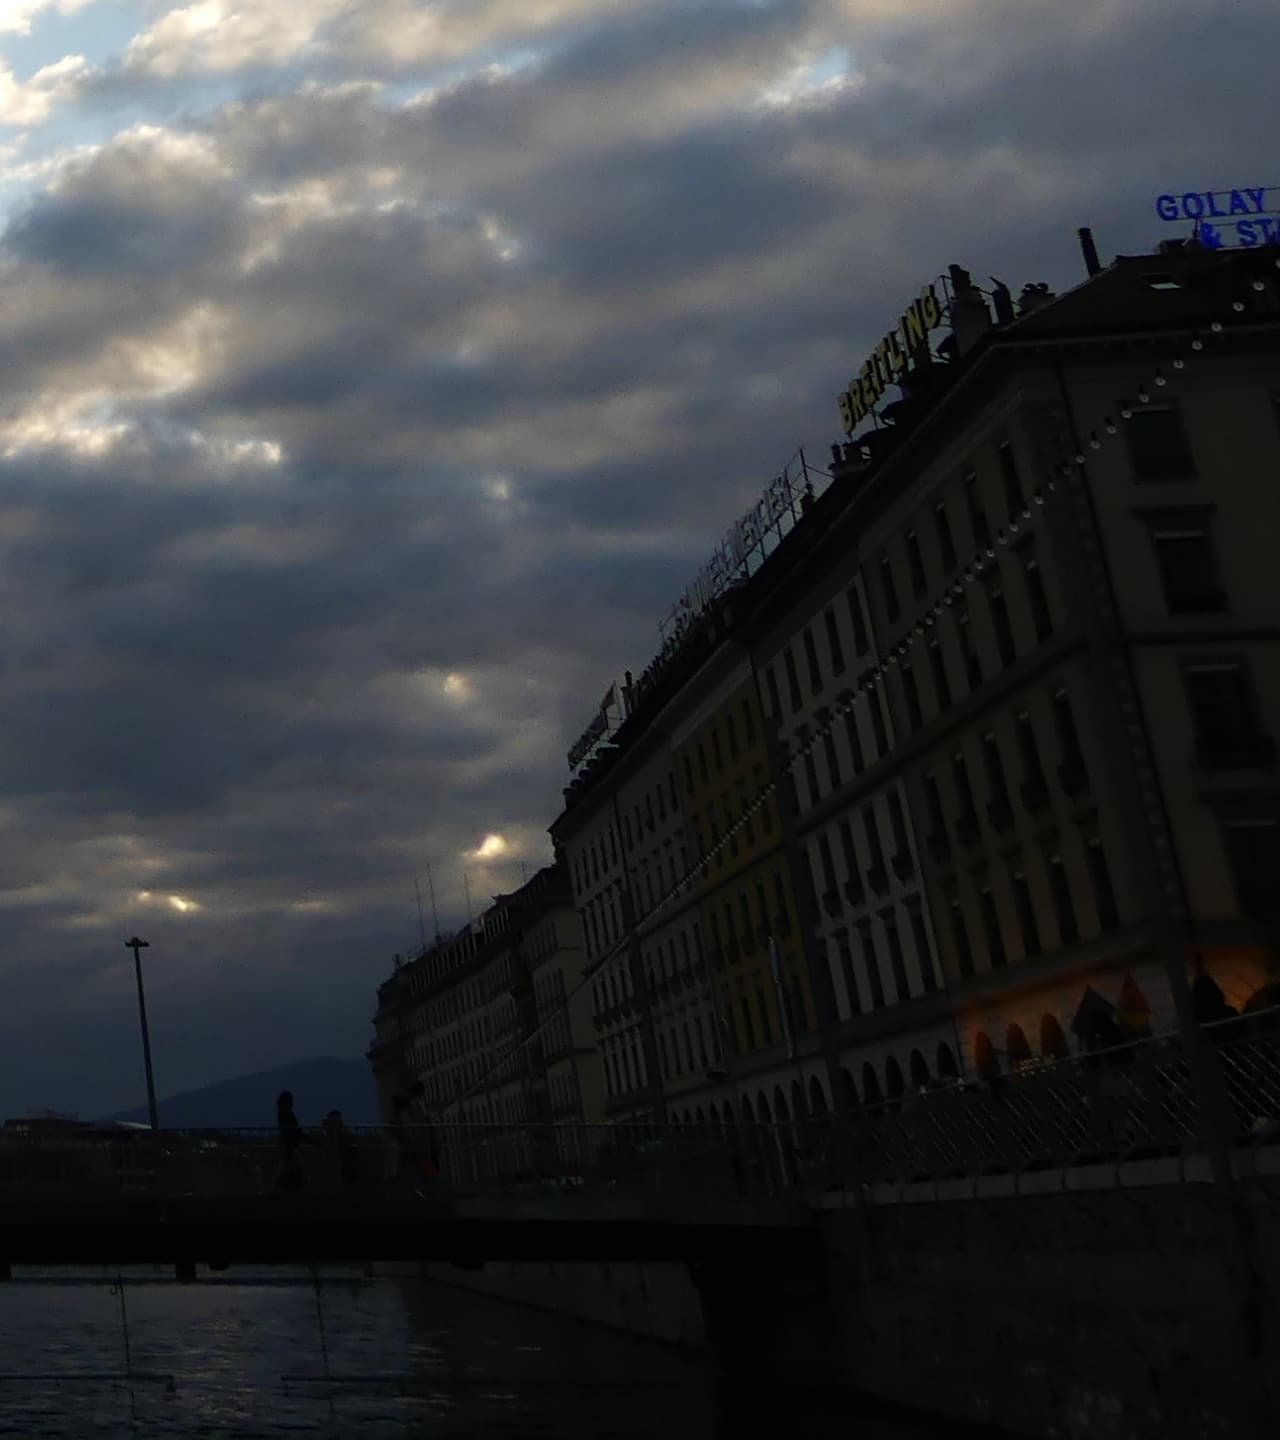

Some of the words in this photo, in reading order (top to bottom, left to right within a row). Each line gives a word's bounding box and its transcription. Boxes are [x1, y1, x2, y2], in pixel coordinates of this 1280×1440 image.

[1156, 187, 1265, 221] GOLAY
[1201, 222, 1223, 250] &
[1237, 218, 1280, 248] ST
[838, 284, 941, 434] BREITLING
